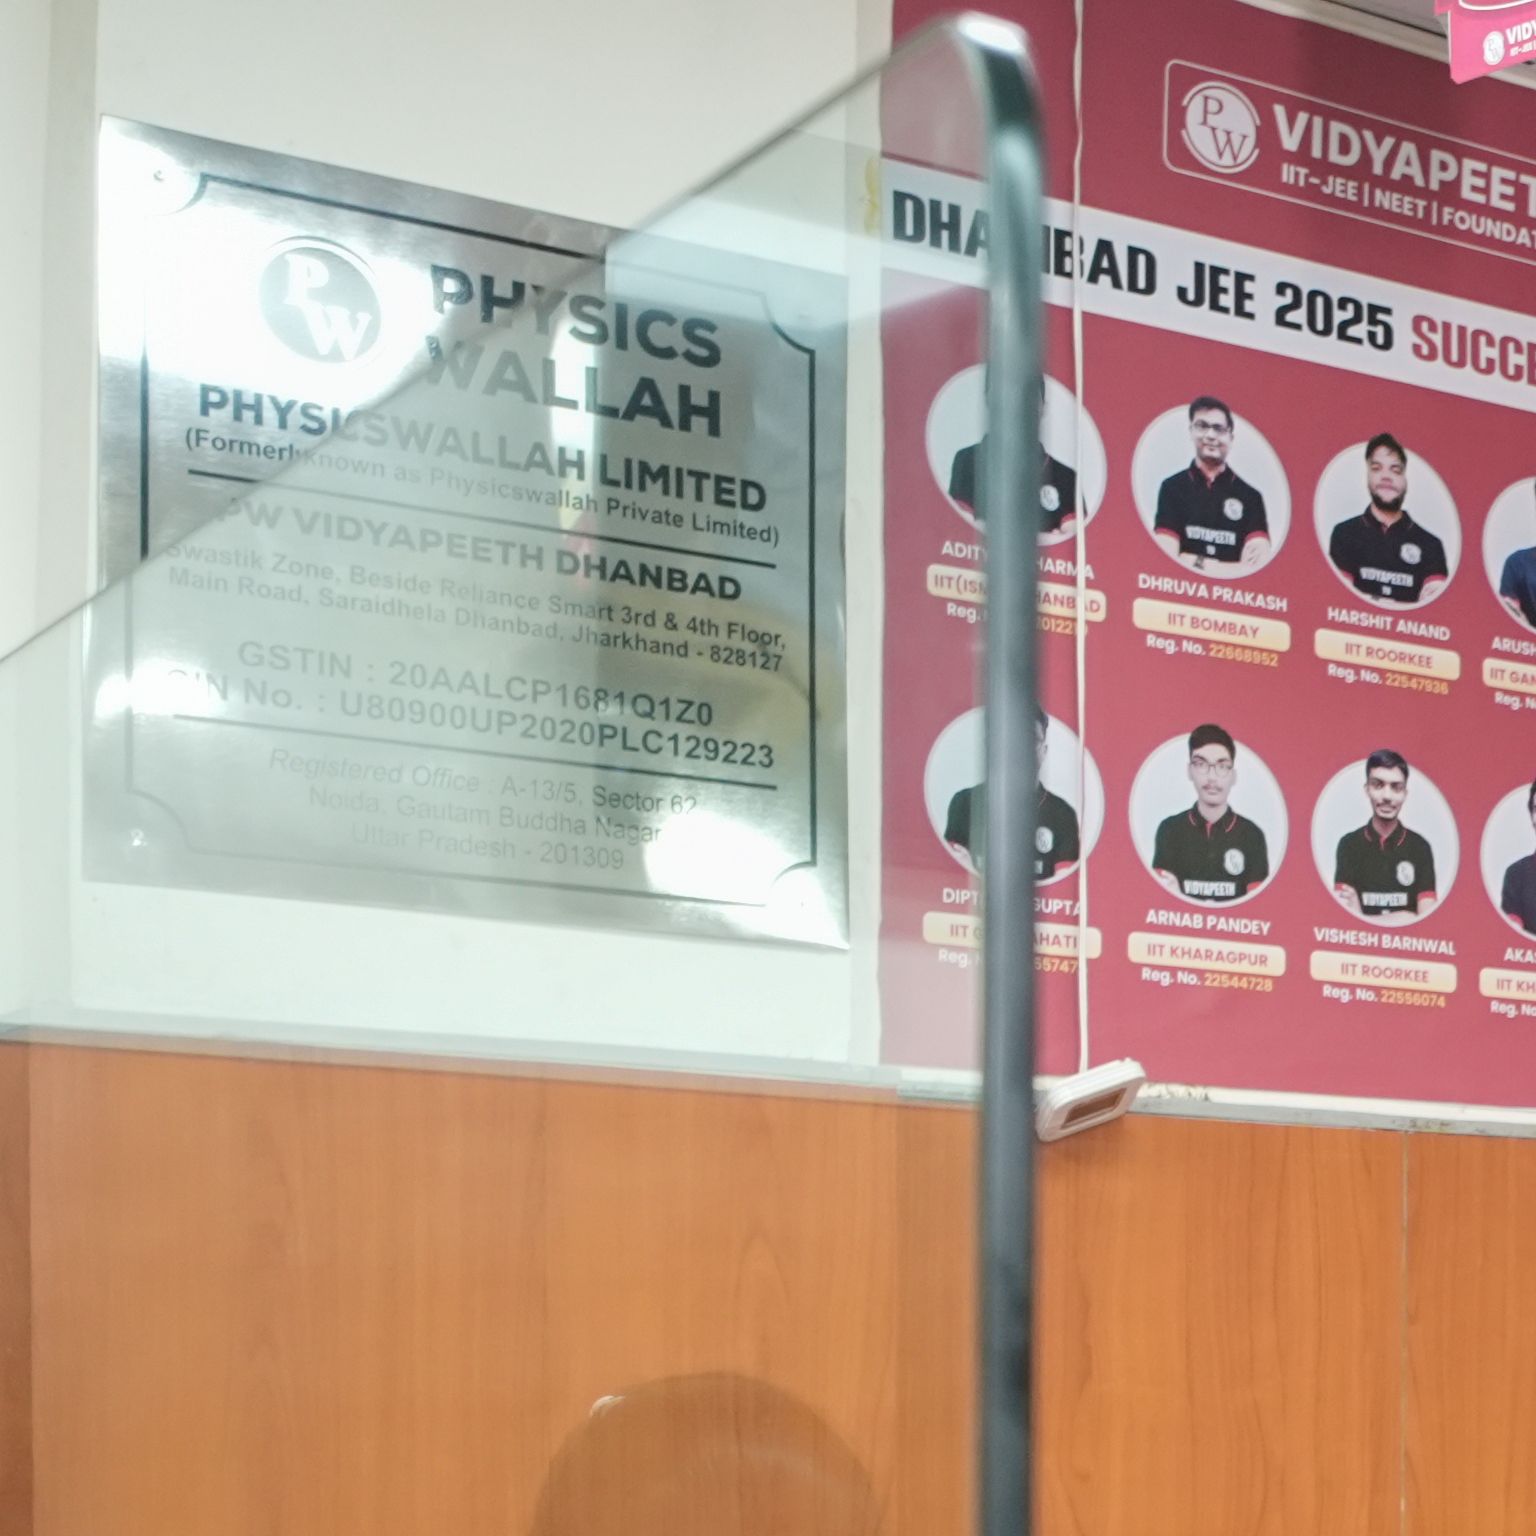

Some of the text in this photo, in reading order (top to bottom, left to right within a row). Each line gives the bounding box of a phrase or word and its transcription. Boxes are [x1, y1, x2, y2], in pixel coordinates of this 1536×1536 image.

[1281, 163, 1359, 203] IIT-JEE
[1374, 189, 1427, 220] NEET
[893, 190, 1157, 297] DHABAD
[1177, 261, 1256, 321] JEE
[1275, 281, 1394, 352] 2025
[430, 265, 722, 368] PHYSICS
[425, 336, 721, 438] WALLAH
[200, 383, 767, 512] PHYSICSWALLAH LIMITED
[394, 467, 421, 483] as
[429, 466, 598, 512] Physicswallah
[607, 498, 684, 528] Private
[692, 513, 779, 548] Limited)
[291, 506, 544, 572] VIDYAPEETH
[556, 550, 742, 601] DHANBAD
[166, 544, 262, 571] Swastik
[350, 565, 432, 595] Beside
[440, 578, 540, 611] Reliance
[548, 595, 614, 622] Smart
[621, 601, 655, 627] 3rd
[664, 611, 678, 631] &
[686, 611, 718, 638] 4th
[728, 622, 785, 650] Floor,
[1138, 573, 1287, 612] DHRUVA PRAKASH
[168, 566, 228, 593] Main
[238, 575, 309, 606] Road,
[319, 587, 445, 623] Saraidhela
[455, 607, 564, 642] Dhanbad,
[572, 625, 688, 658] Jharkhand
[710, 645, 782, 672] 828127
[947, 602, 981, 624] Reg.
[1168, 612, 1259, 639] IIT BOMBAY
[1328, 607, 1451, 641] HARSHIT ANAND
[238, 640, 352, 678] GSTIN
[1147, 634, 1178, 654] Reg.
[1182, 640, 1206, 655] No.
[1345, 643, 1433, 669] IIT ROORKEE
[1328, 664, 1357, 684] Reg.
[1360, 669, 1382, 684] No.
[1490, 668, 1506, 680] IIT
[1495, 691, 1522, 710] Reg.
[244, 679, 303, 711] No.
[341, 690, 774, 769] U80900UP2020PLC129223
[270, 748, 403, 784] Registered
[412, 765, 479, 793] Office
[593, 785, 664, 813] Sector
[397, 794, 490, 827] Gautam
[500, 806, 586, 835] Buddha
[595, 817, 662, 845] Nagar
[418, 829, 516, 858] Pradesh
[540, 842, 624, 870] 201309
[950, 923, 969, 937] IIT
[1146, 909, 1271, 936] ARNAB PANDEY
[1147, 943, 1268, 967] IIT KHARAGPUR
[1313, 926, 1456, 956] VISHESH BARNWAL
[1142, 967, 1174, 986] Reg.
[1177, 971, 1201, 986] No.
[1341, 962, 1429, 983] IIT ROORKEE
[1497, 978, 1513, 990] IIT
[1323, 984, 1352, 1003] Reg.
[1356, 988, 1378, 1002] No.
[1490, 1000, 1518, 1018] Reg.
